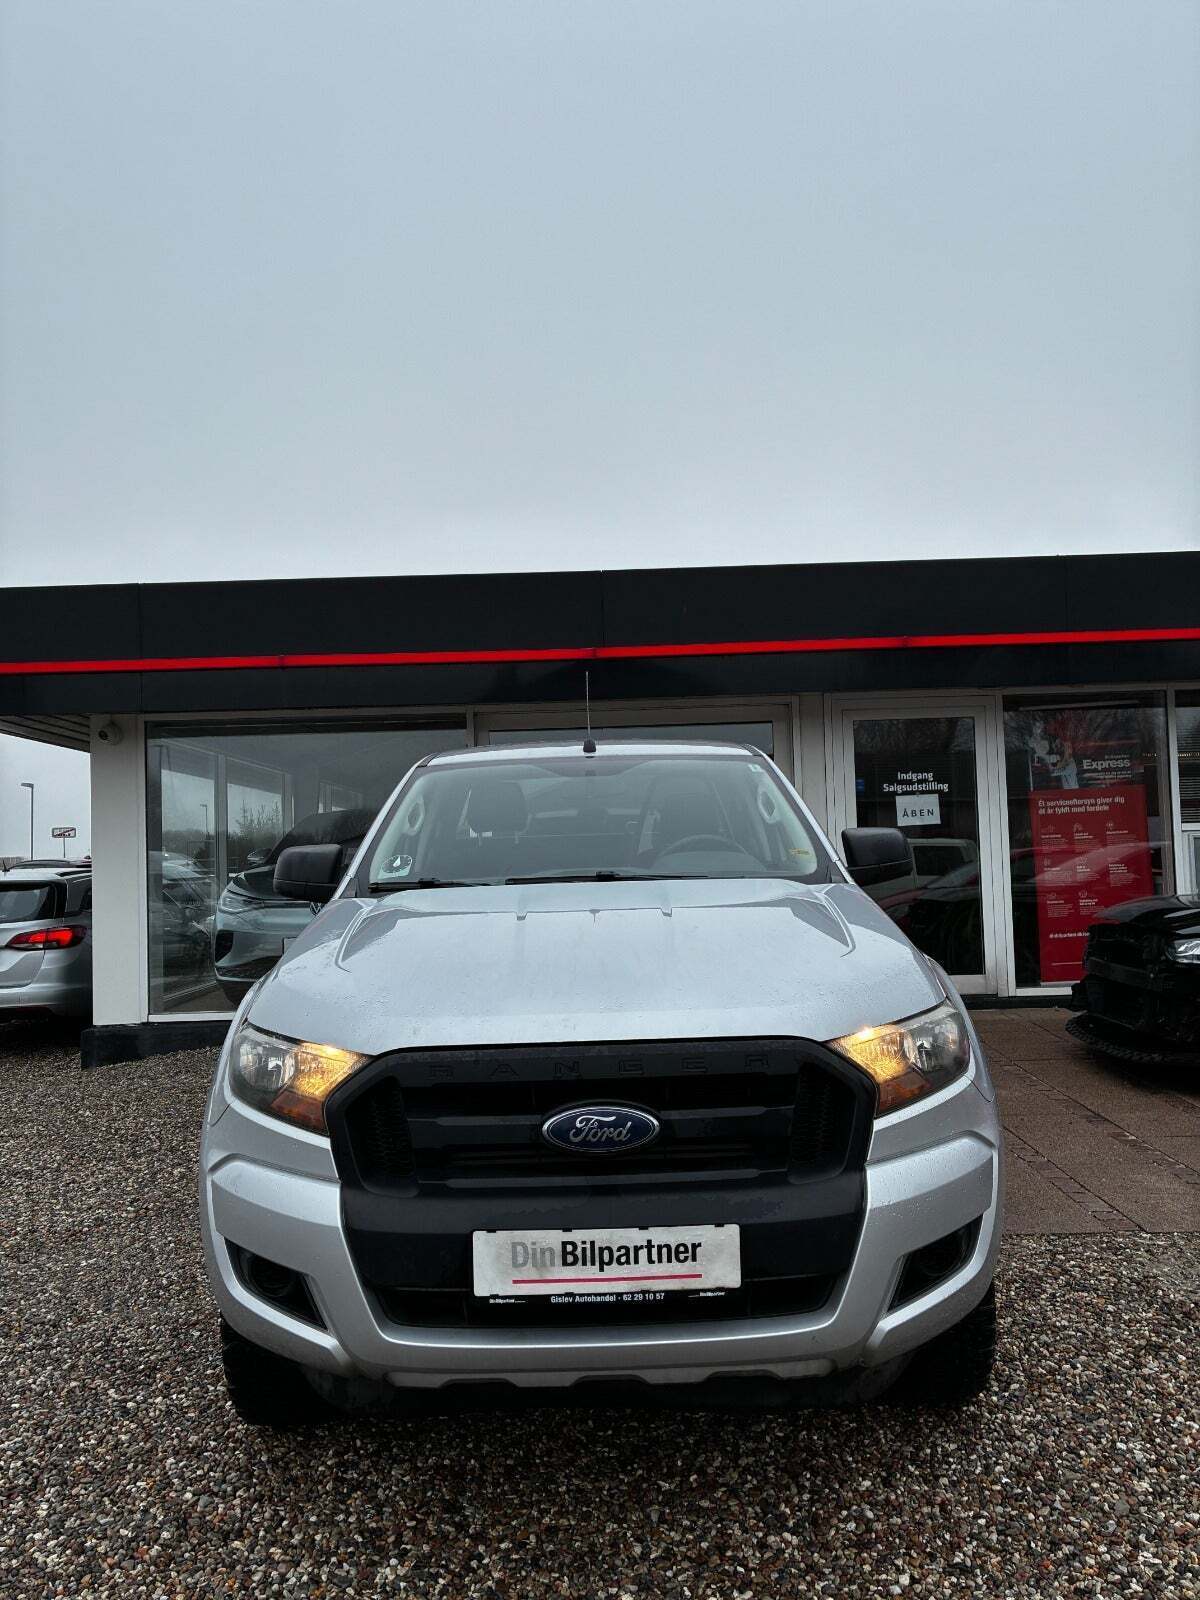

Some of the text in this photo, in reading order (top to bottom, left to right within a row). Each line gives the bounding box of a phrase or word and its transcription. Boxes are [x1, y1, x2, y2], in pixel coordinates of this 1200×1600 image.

[1082, 759, 1130, 770] Express
[897, 771, 934, 781] Indgang
[883, 781, 949, 793] Salgsudstilling
[902, 808, 934, 818] ÅBEN
[429, 1054, 769, 1079] RANGER
[569, 1115, 632, 1142] Ford
